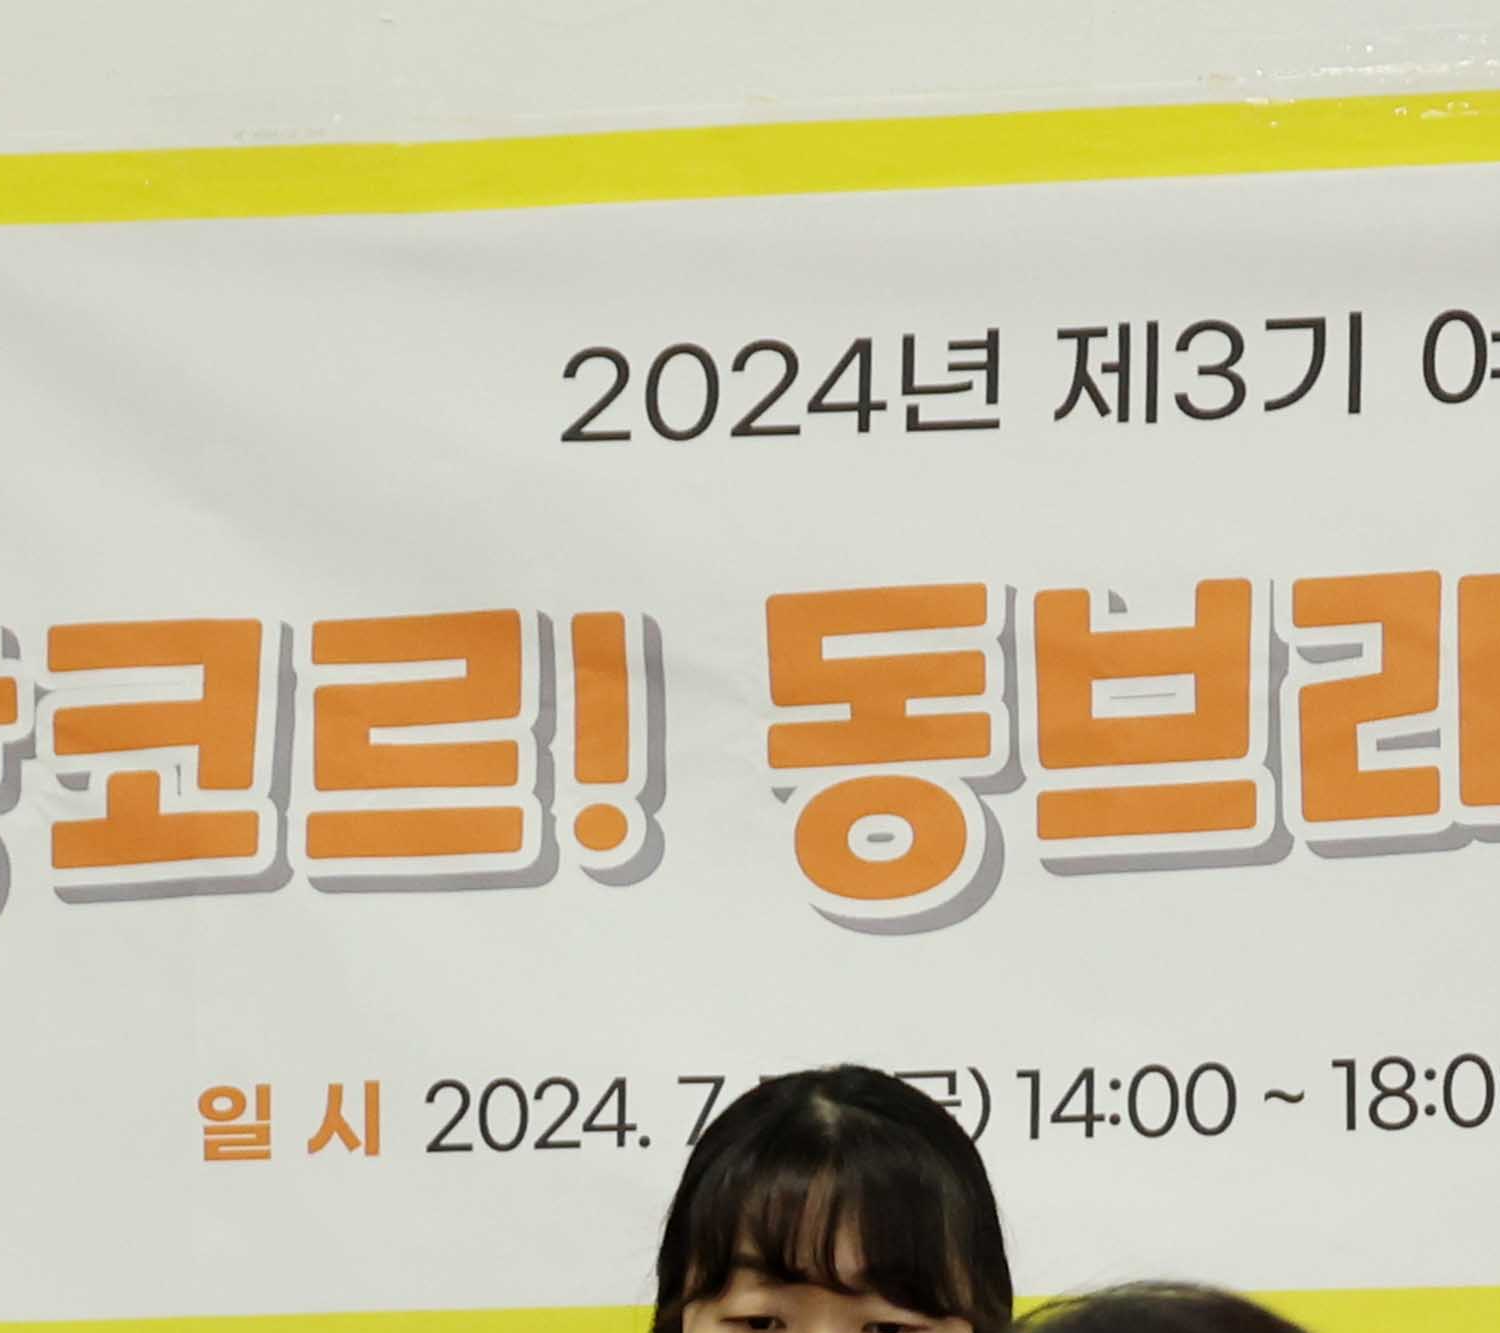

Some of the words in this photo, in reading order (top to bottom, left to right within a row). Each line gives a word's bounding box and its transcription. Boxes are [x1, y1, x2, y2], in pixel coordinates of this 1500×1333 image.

[560, 327, 1001, 443] 2024년
[1053, 311, 1363, 424] 제3기
[425, 1077, 651, 1153] 2024.
[1016, 1062, 1237, 1140] 14:00
